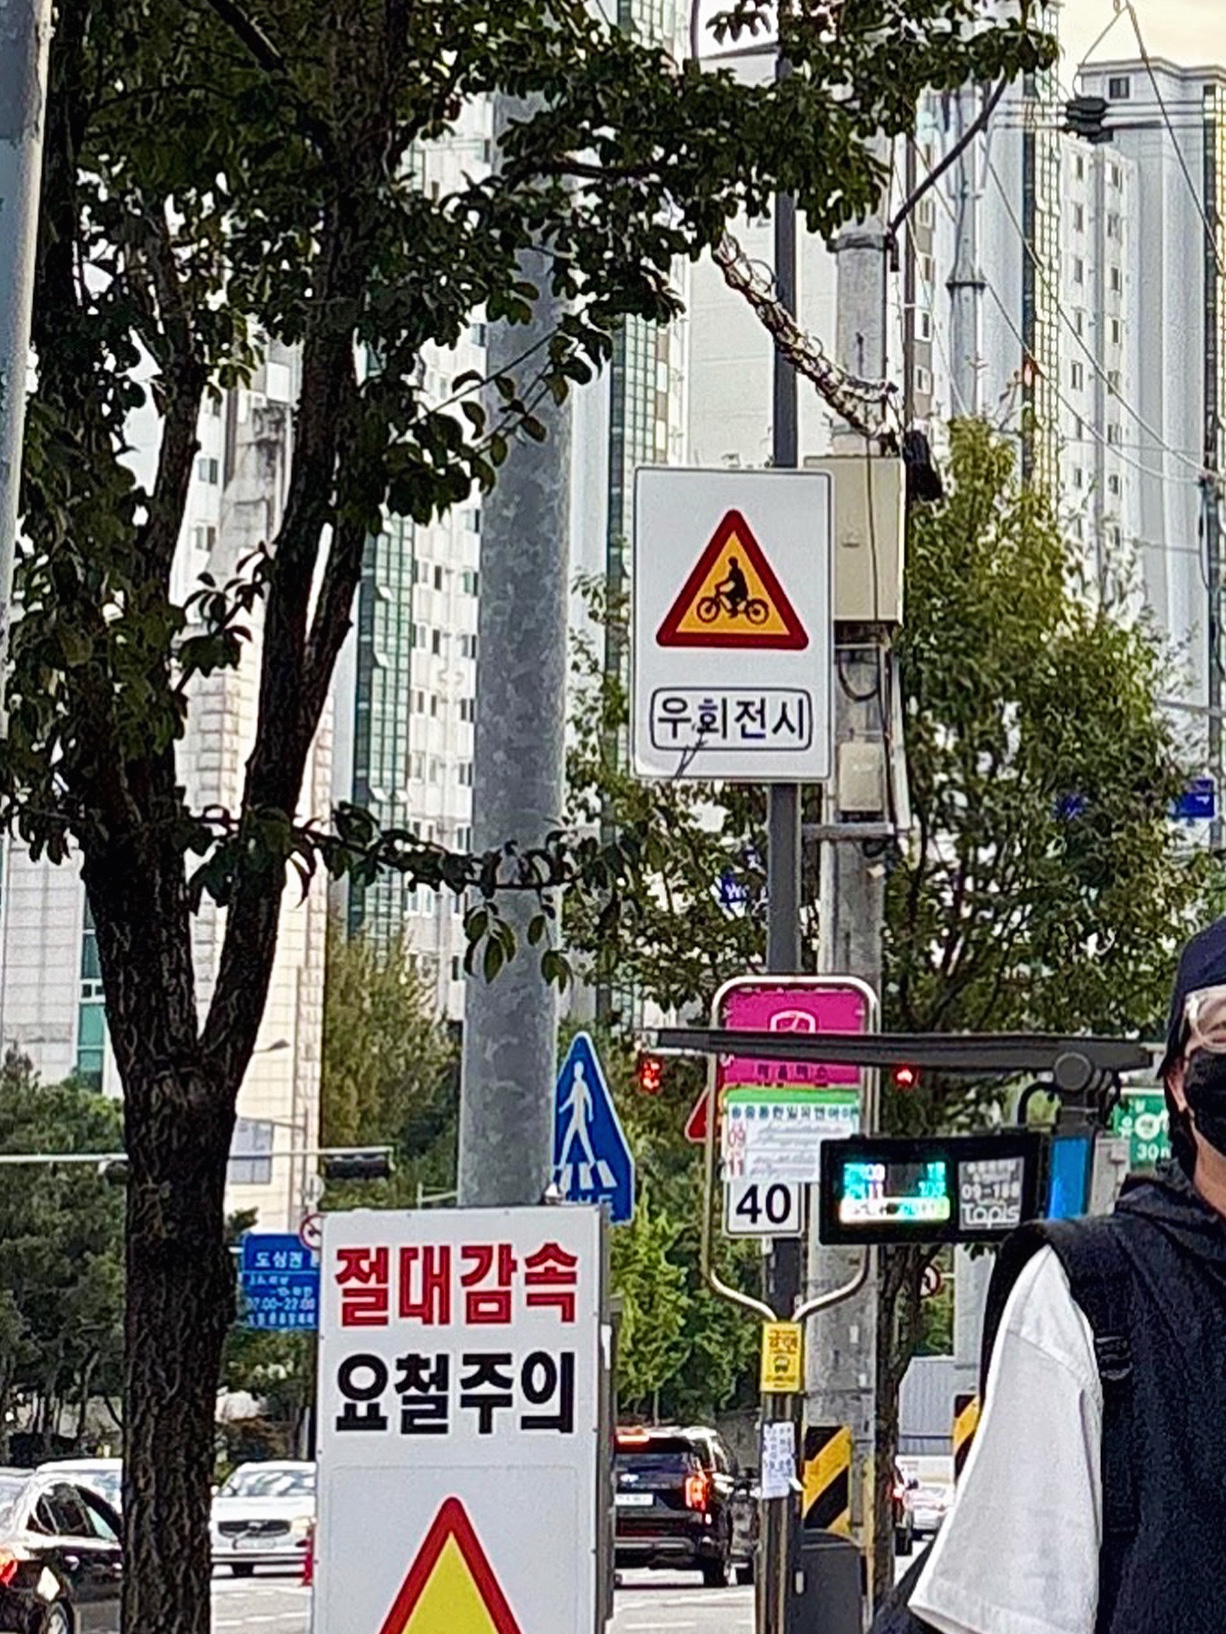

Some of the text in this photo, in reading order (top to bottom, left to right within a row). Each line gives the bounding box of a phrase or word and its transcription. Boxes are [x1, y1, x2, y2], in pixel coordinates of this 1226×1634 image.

[657, 696, 804, 740] 우회전시
[736, 1183, 791, 1224] 40
[335, 1242, 579, 1327] 절대감속
[335, 1351, 576, 1435] 요철주의
